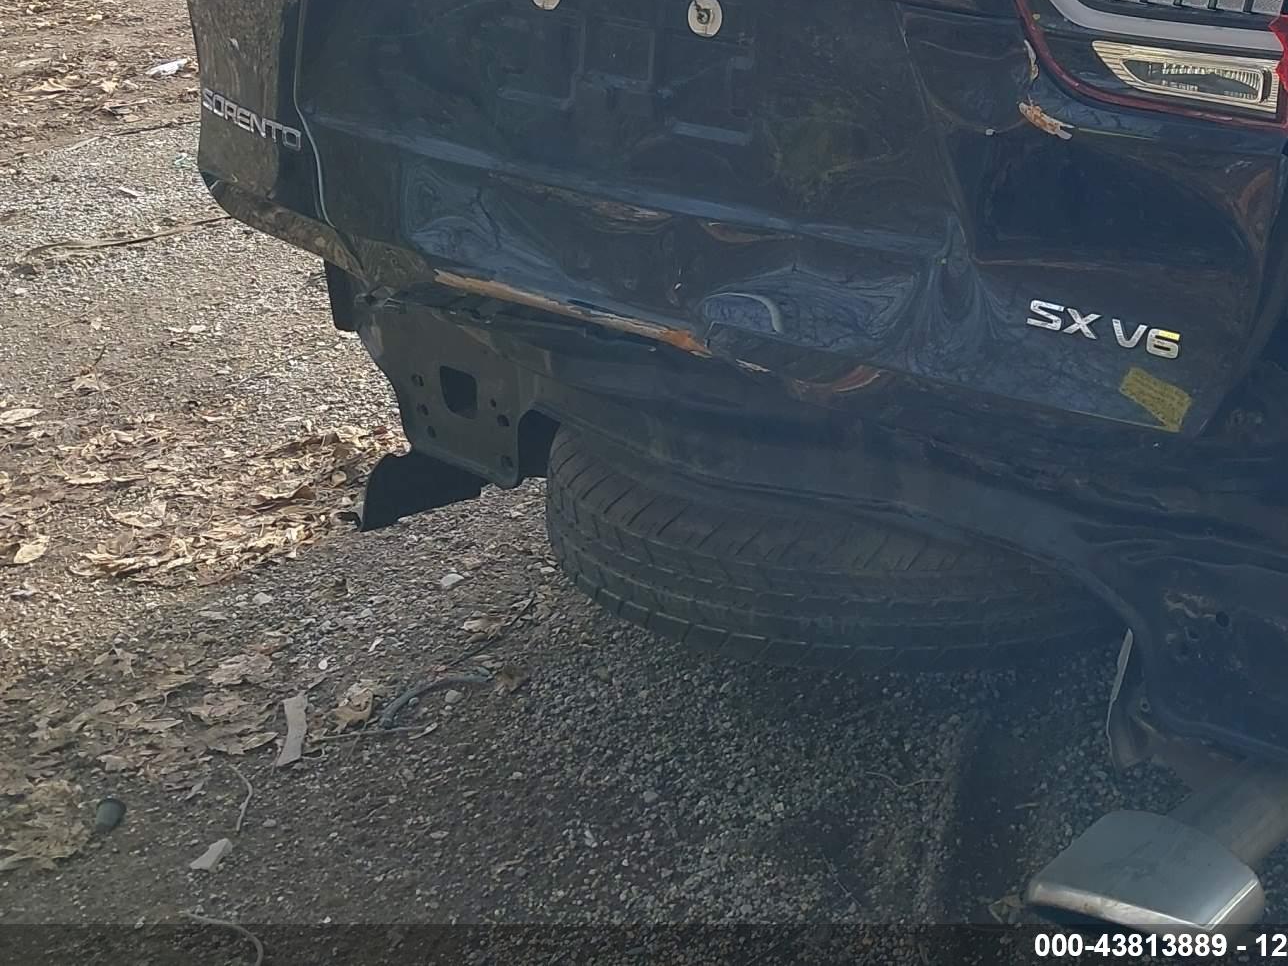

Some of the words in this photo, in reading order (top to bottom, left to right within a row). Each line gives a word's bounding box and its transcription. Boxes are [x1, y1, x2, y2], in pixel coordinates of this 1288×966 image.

[202, 88, 301, 151] SORENTO
[1026, 299, 1101, 340] SX
[1112, 318, 1181, 359] V6
